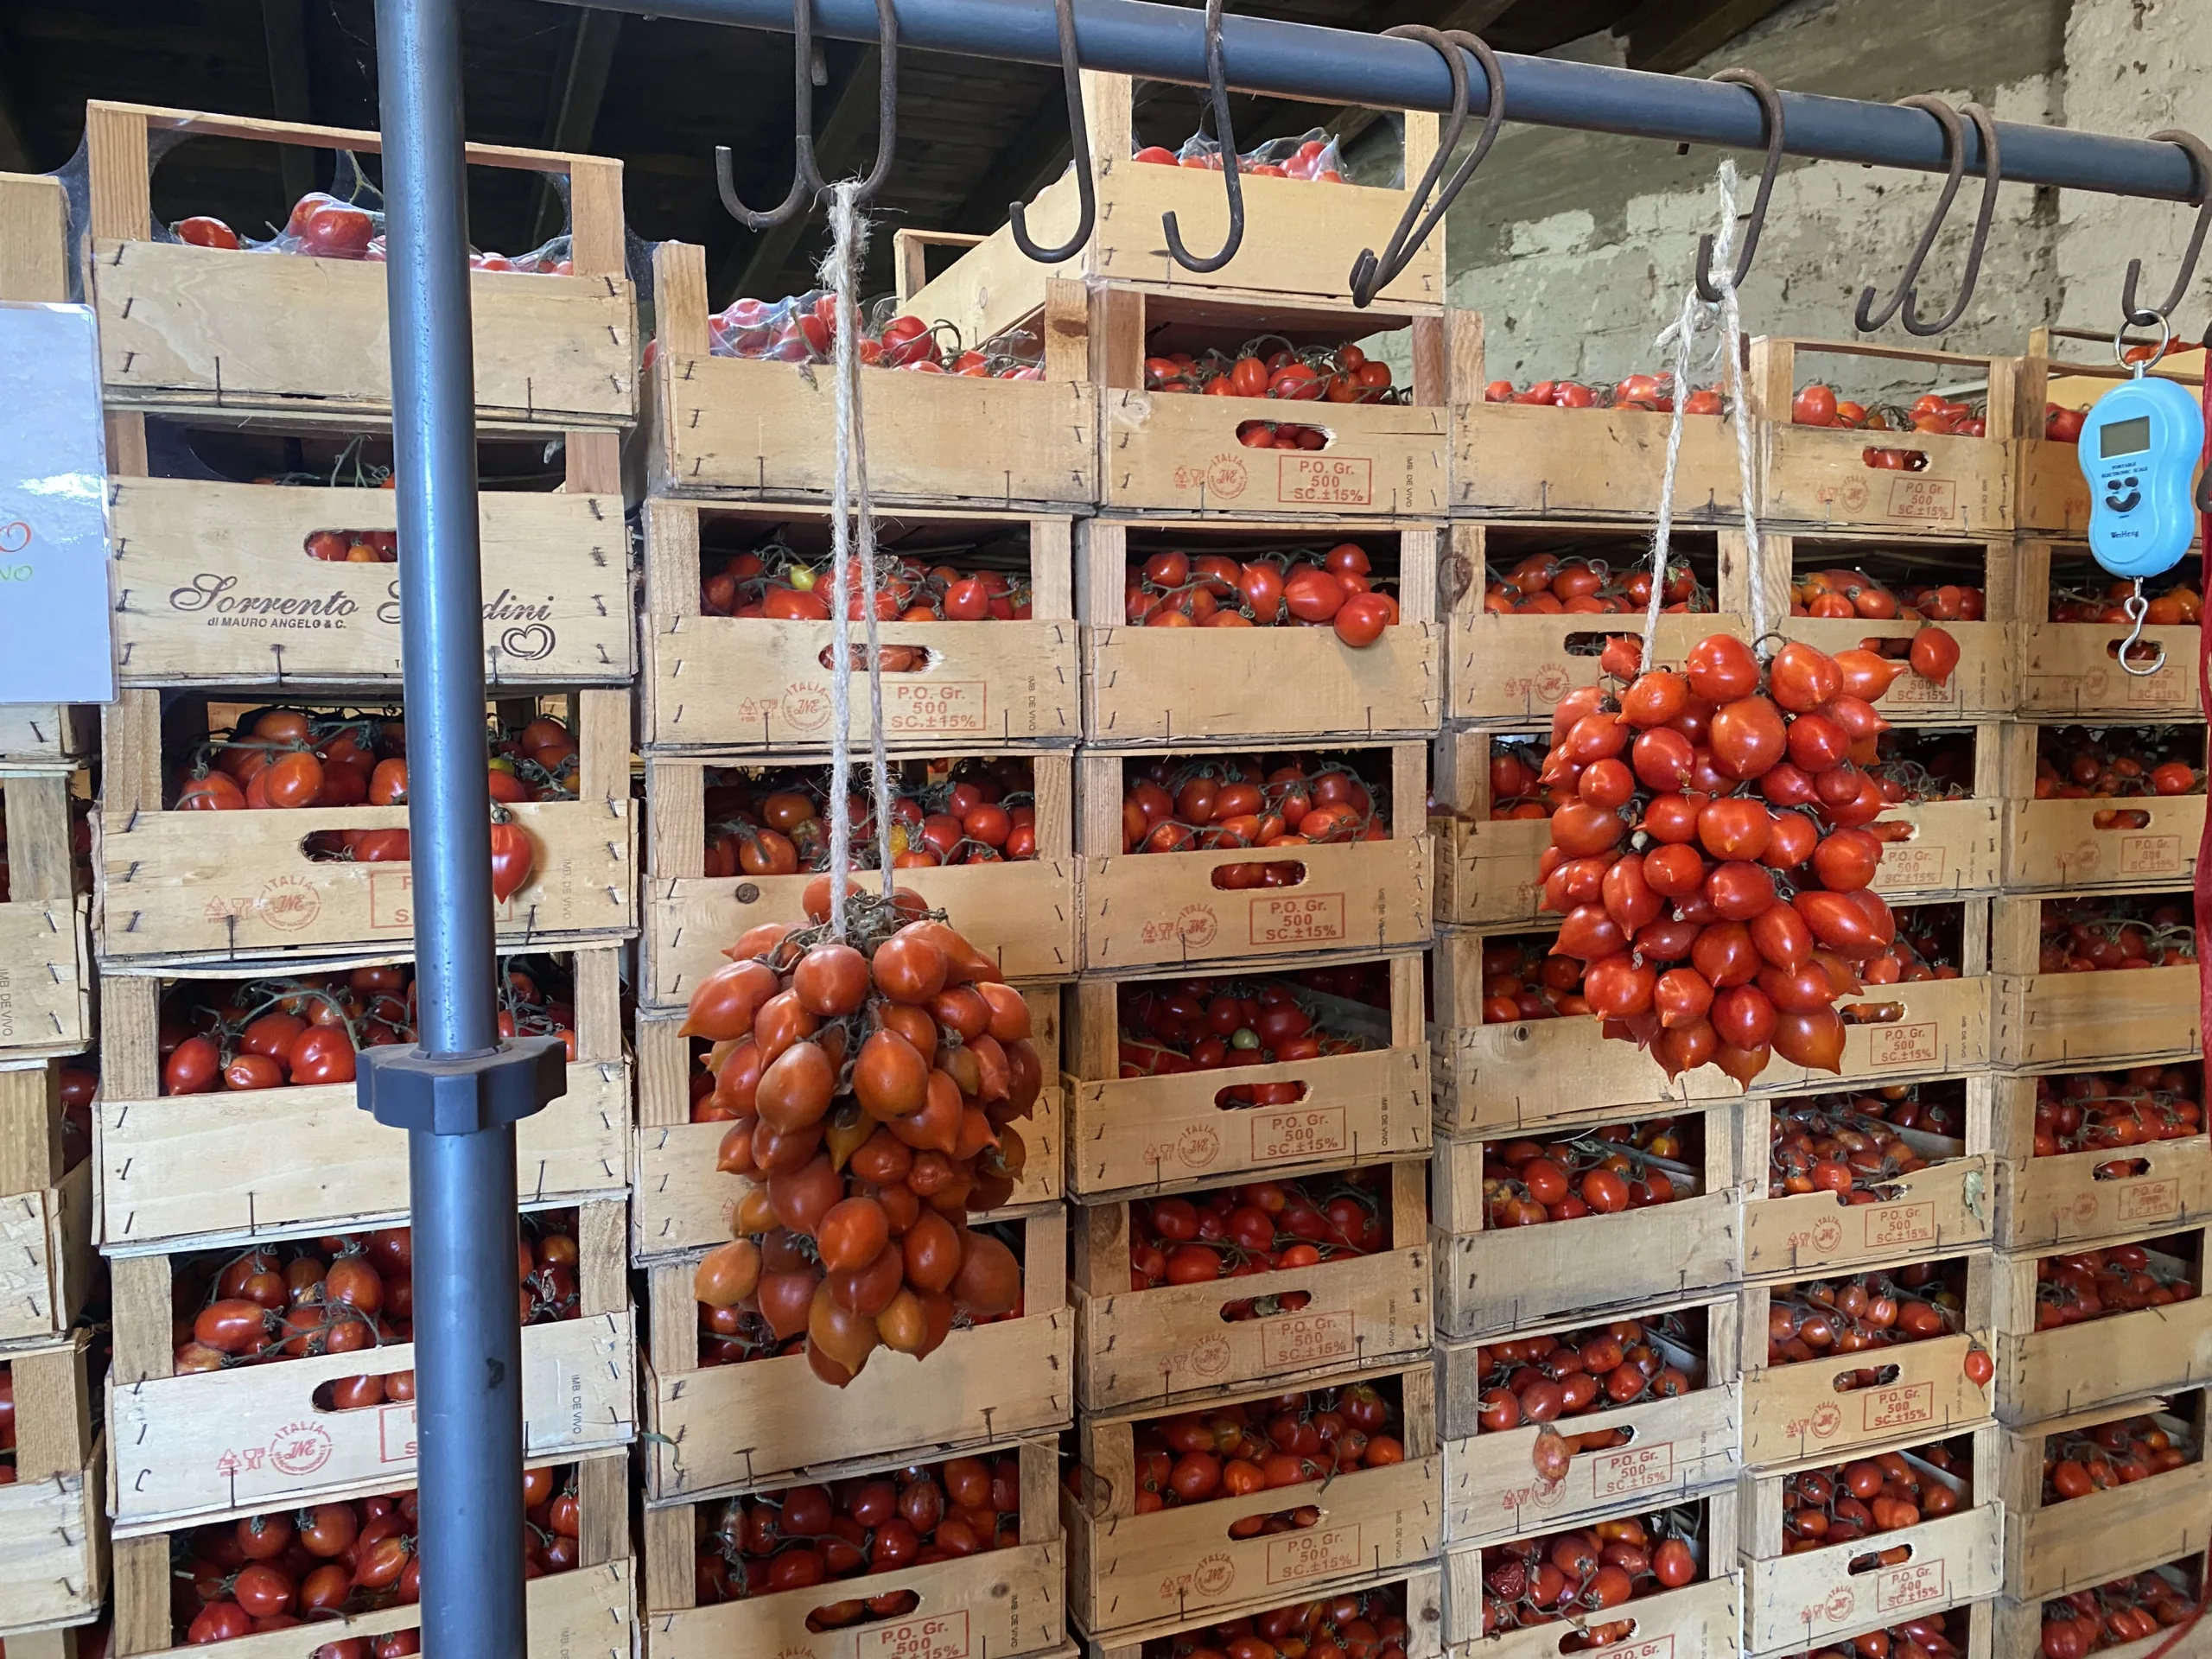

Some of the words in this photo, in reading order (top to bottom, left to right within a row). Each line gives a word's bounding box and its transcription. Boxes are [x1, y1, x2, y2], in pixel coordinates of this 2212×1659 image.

[1300, 461, 1328, 474] P.O.
[1333, 462, 1355, 474] Gr.
[1311, 476, 1339, 488] 500
[1905, 483, 1925, 493] P.O.
[1929, 484, 1943, 494] Gr.
[1911, 495, 1932, 505] 500
[169, 573, 359, 616] Sorrento
[221, 618, 268, 627] MAURO
[270, 619, 321, 629] ANGELO
[324, 620, 333, 629] &
[1910, 680, 1931, 690] 500
[898, 686, 931, 699] P.O.
[940, 687, 965, 700] Gr.
[912, 702, 948, 714] 500
[1915, 851, 1932, 861] Gr.
[1897, 863, 1920, 872] 500
[1271, 900, 1300, 914] P.O.
[1306, 899, 1327, 912] Gr.
[1283, 914, 1313, 926] 500
[1, 994, 11, 1008] DE
[2, 1010, 13, 1036] VIVO
[1885, 1030, 1906, 1040] P.O.
[1910, 1028, 1925, 1039] Gr.
[1894, 1039, 1915, 1050] 500
[1272, 1117, 1300, 1130] P.O.
[1306, 1115, 1328, 1126] Gr.
[1285, 1128, 1313, 1141] 500
[1880, 1211, 1902, 1222] P.O.
[1906, 1208, 1921, 1218] Gr.
[1889, 1220, 1910, 1230] 500
[1281, 1319, 1310, 1335] P.O.
[1316, 1318, 1336, 1331] Gr.
[1294, 1332, 1323, 1346] 500
[572, 1396, 581, 1409] DE
[1879, 1392, 1900, 1404] P.O.
[1904, 1389, 1920, 1400] Gr.
[1888, 1402, 1910, 1414] 500
[572, 1412, 581, 1434] VIVO
[1611, 1454, 1636, 1469] P.O.
[1640, 1451, 1658, 1463] Gr.
[1621, 1465, 1646, 1479] 500
[1287, 1538, 1317, 1553] P.O.
[1322, 1534, 1344, 1546] Gr.
[1300, 1548, 1329, 1563] 500
[1892, 1572, 1912, 1584] P.O.
[1916, 1567, 1932, 1578] Gr.
[1901, 1580, 1922, 1592] 500
[881, 1627, 917, 1644] P.O.
[923, 1622, 948, 1635] Gr.
[897, 1637, 931, 1655] 500
[1642, 1644, 1659, 1657] Gr.
